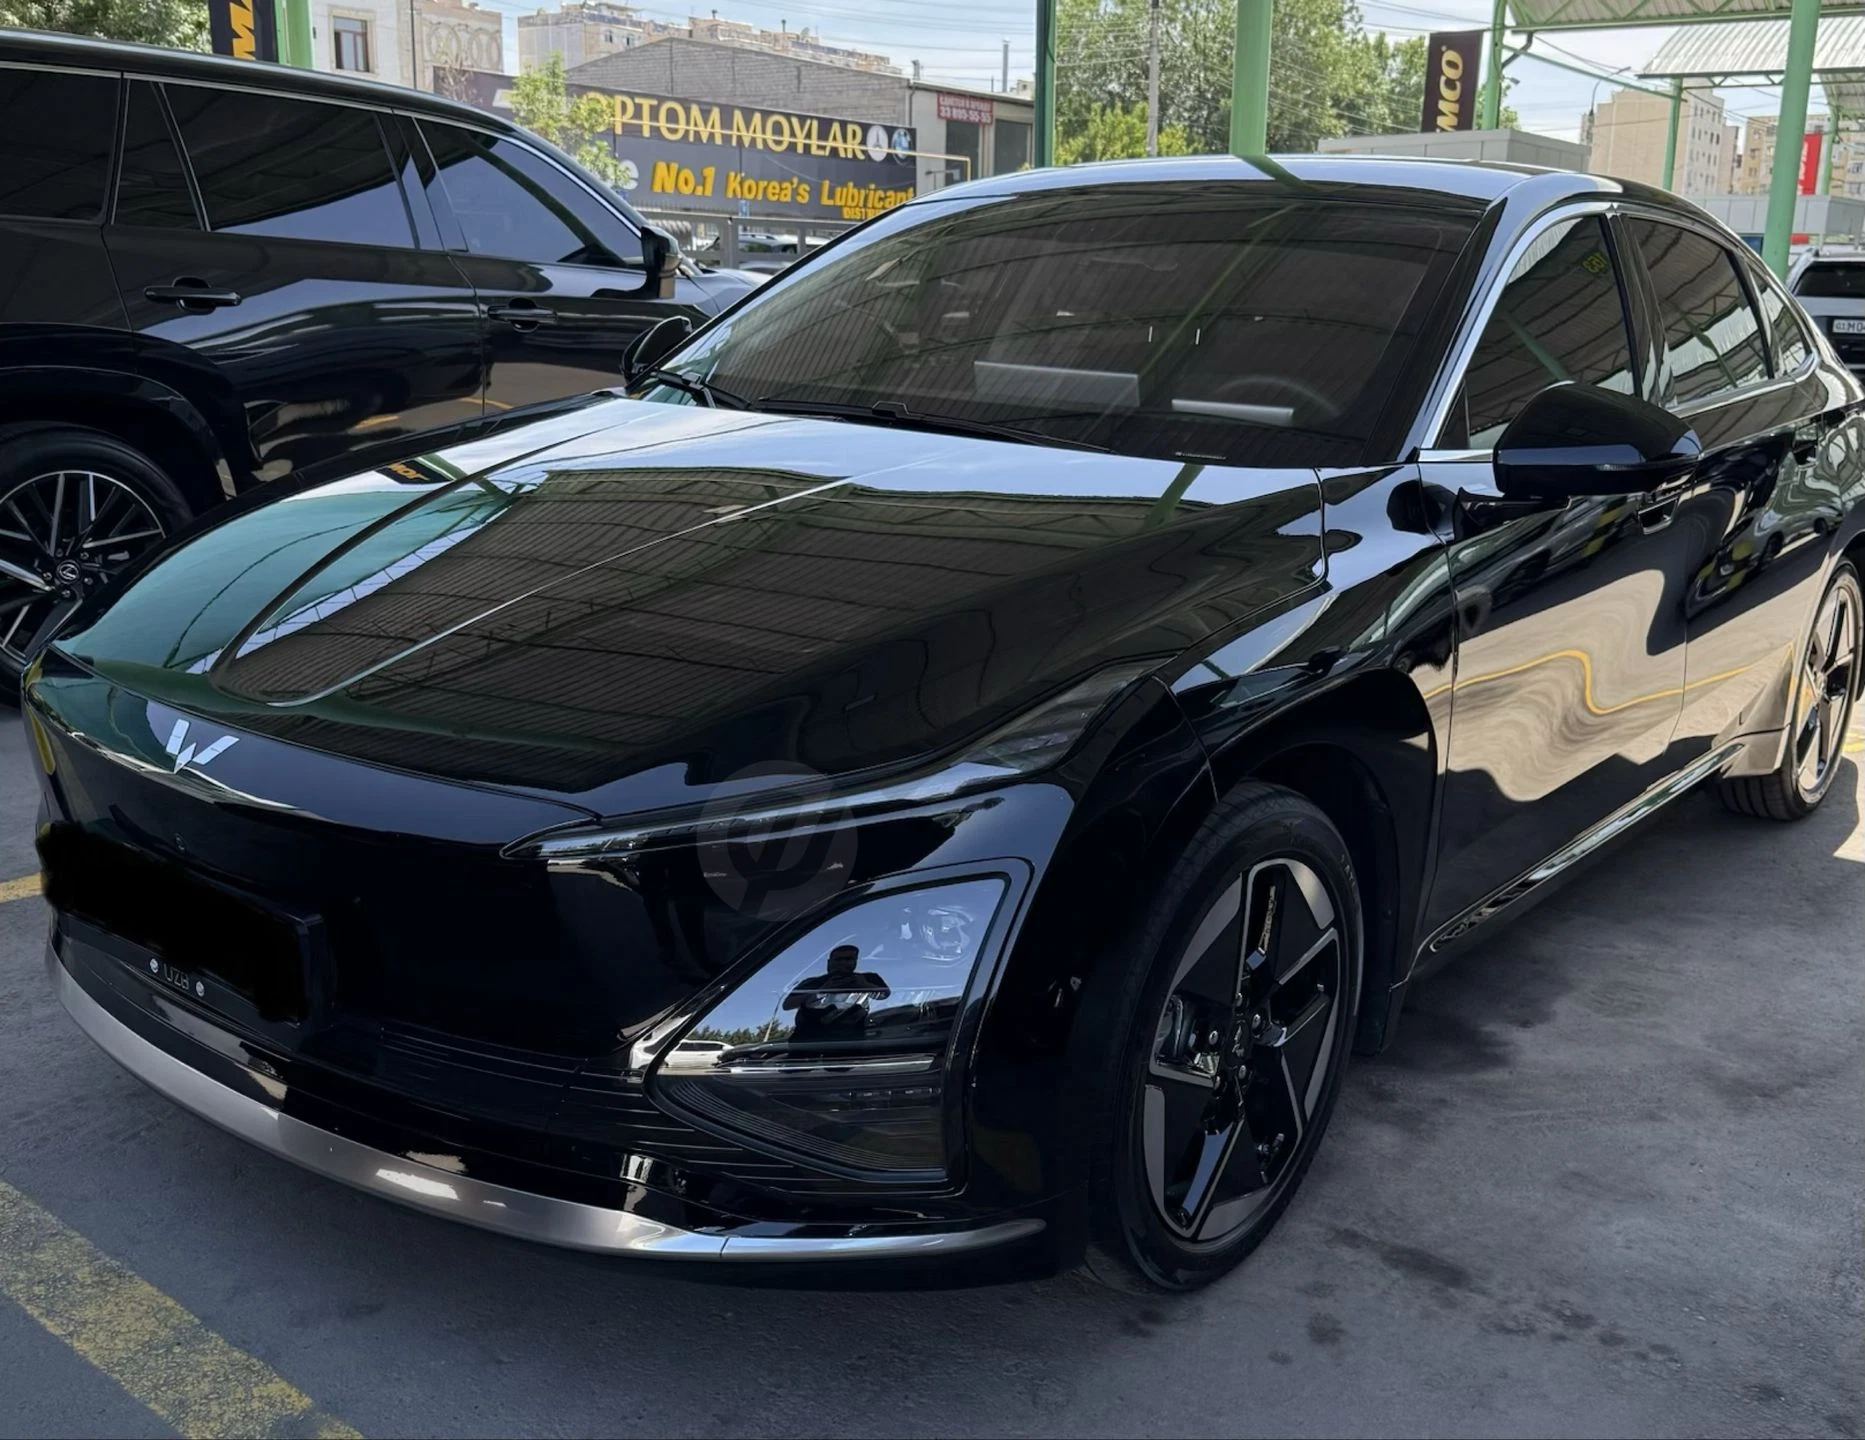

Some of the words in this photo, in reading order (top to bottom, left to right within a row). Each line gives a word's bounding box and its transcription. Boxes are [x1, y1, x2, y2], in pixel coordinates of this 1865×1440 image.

[1437, 49, 1464, 132] MCO
[732, 109, 865, 160] MOYLAR
[653, 161, 715, 196] No.1
[727, 172, 811, 203] Korea's
